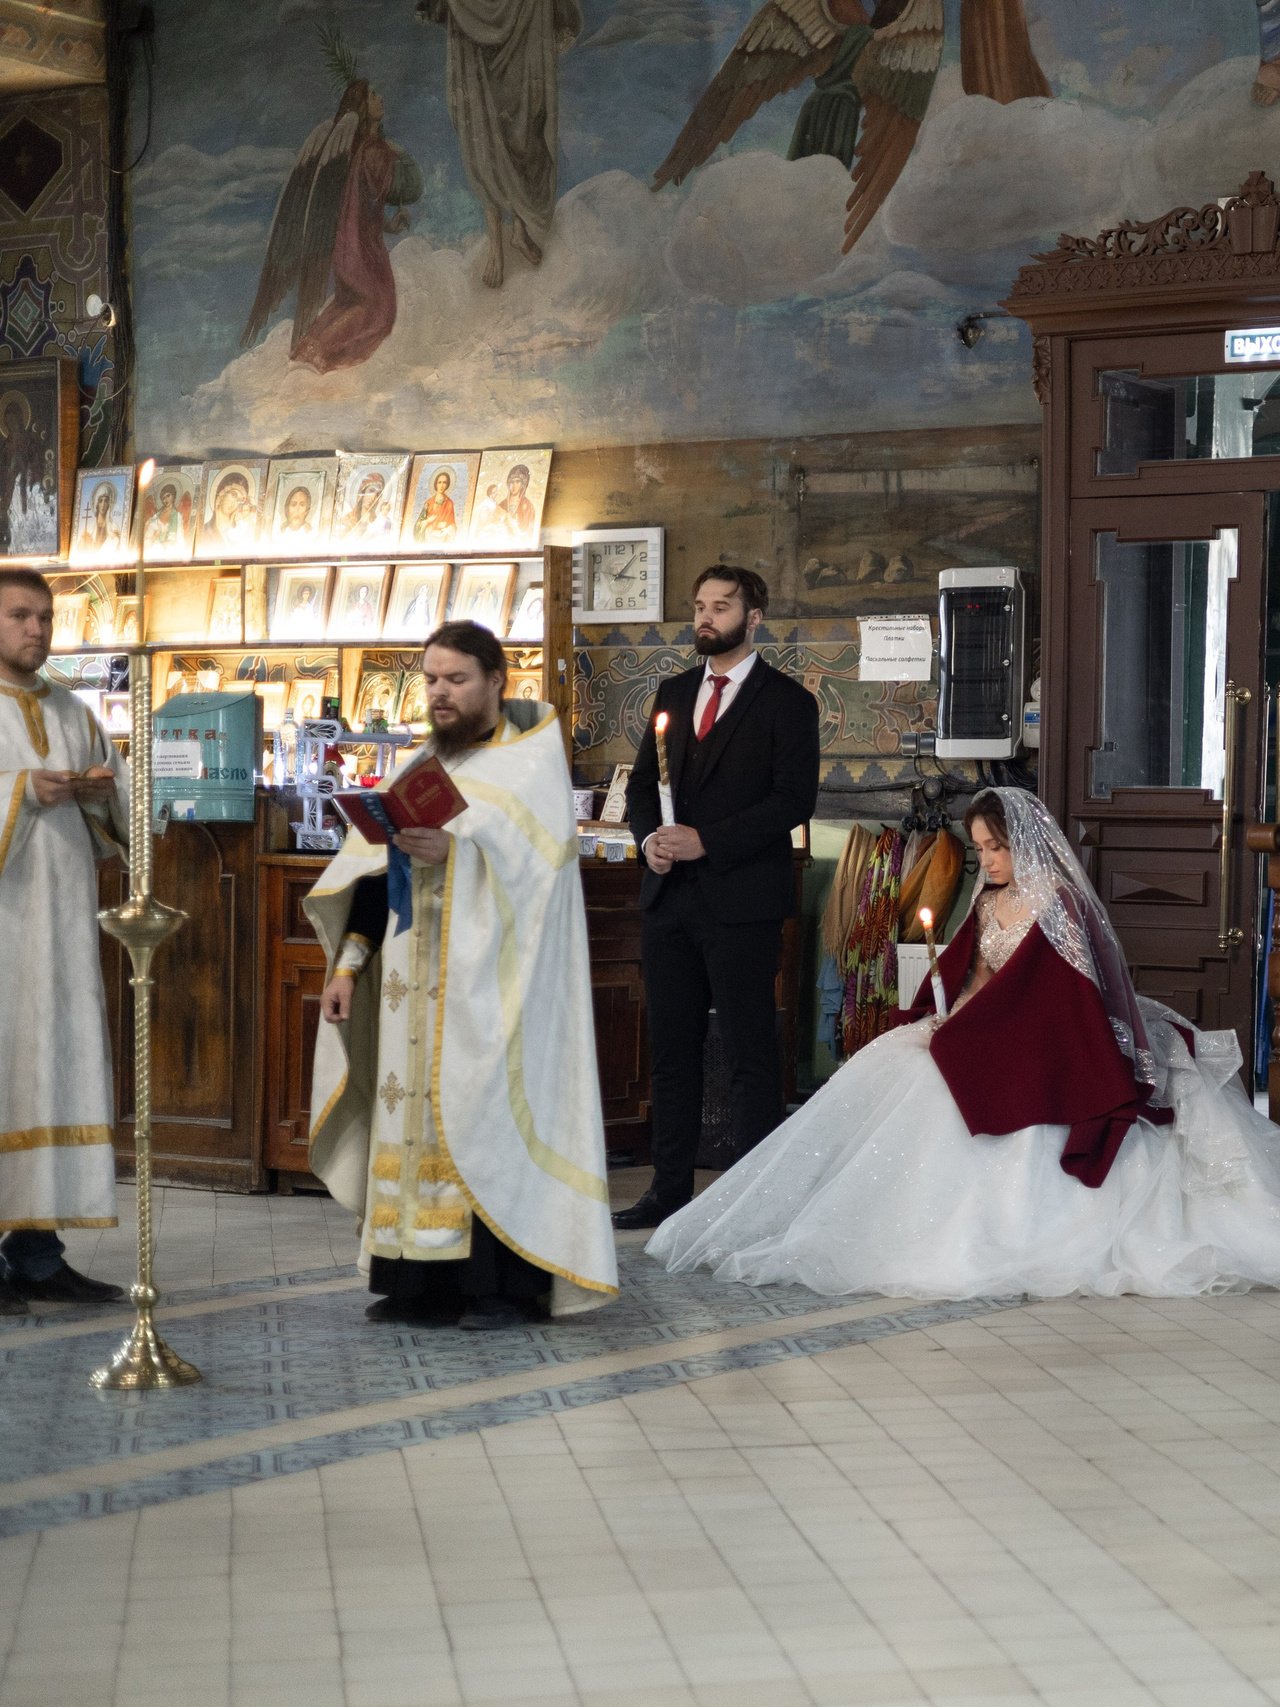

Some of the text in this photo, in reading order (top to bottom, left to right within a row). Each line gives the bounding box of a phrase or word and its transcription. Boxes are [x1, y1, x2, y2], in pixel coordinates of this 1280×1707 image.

[604, 544, 611, 555] 11
[615, 544, 626, 555] 12
[631, 544, 635, 554] 1
[640, 552, 648, 562] 2
[639, 570, 648, 580] 3
[639, 589, 648, 599] 4
[615, 597, 623, 608] 6
[628, 597, 636, 607] 5
[581, 839, 591, 853] 15
